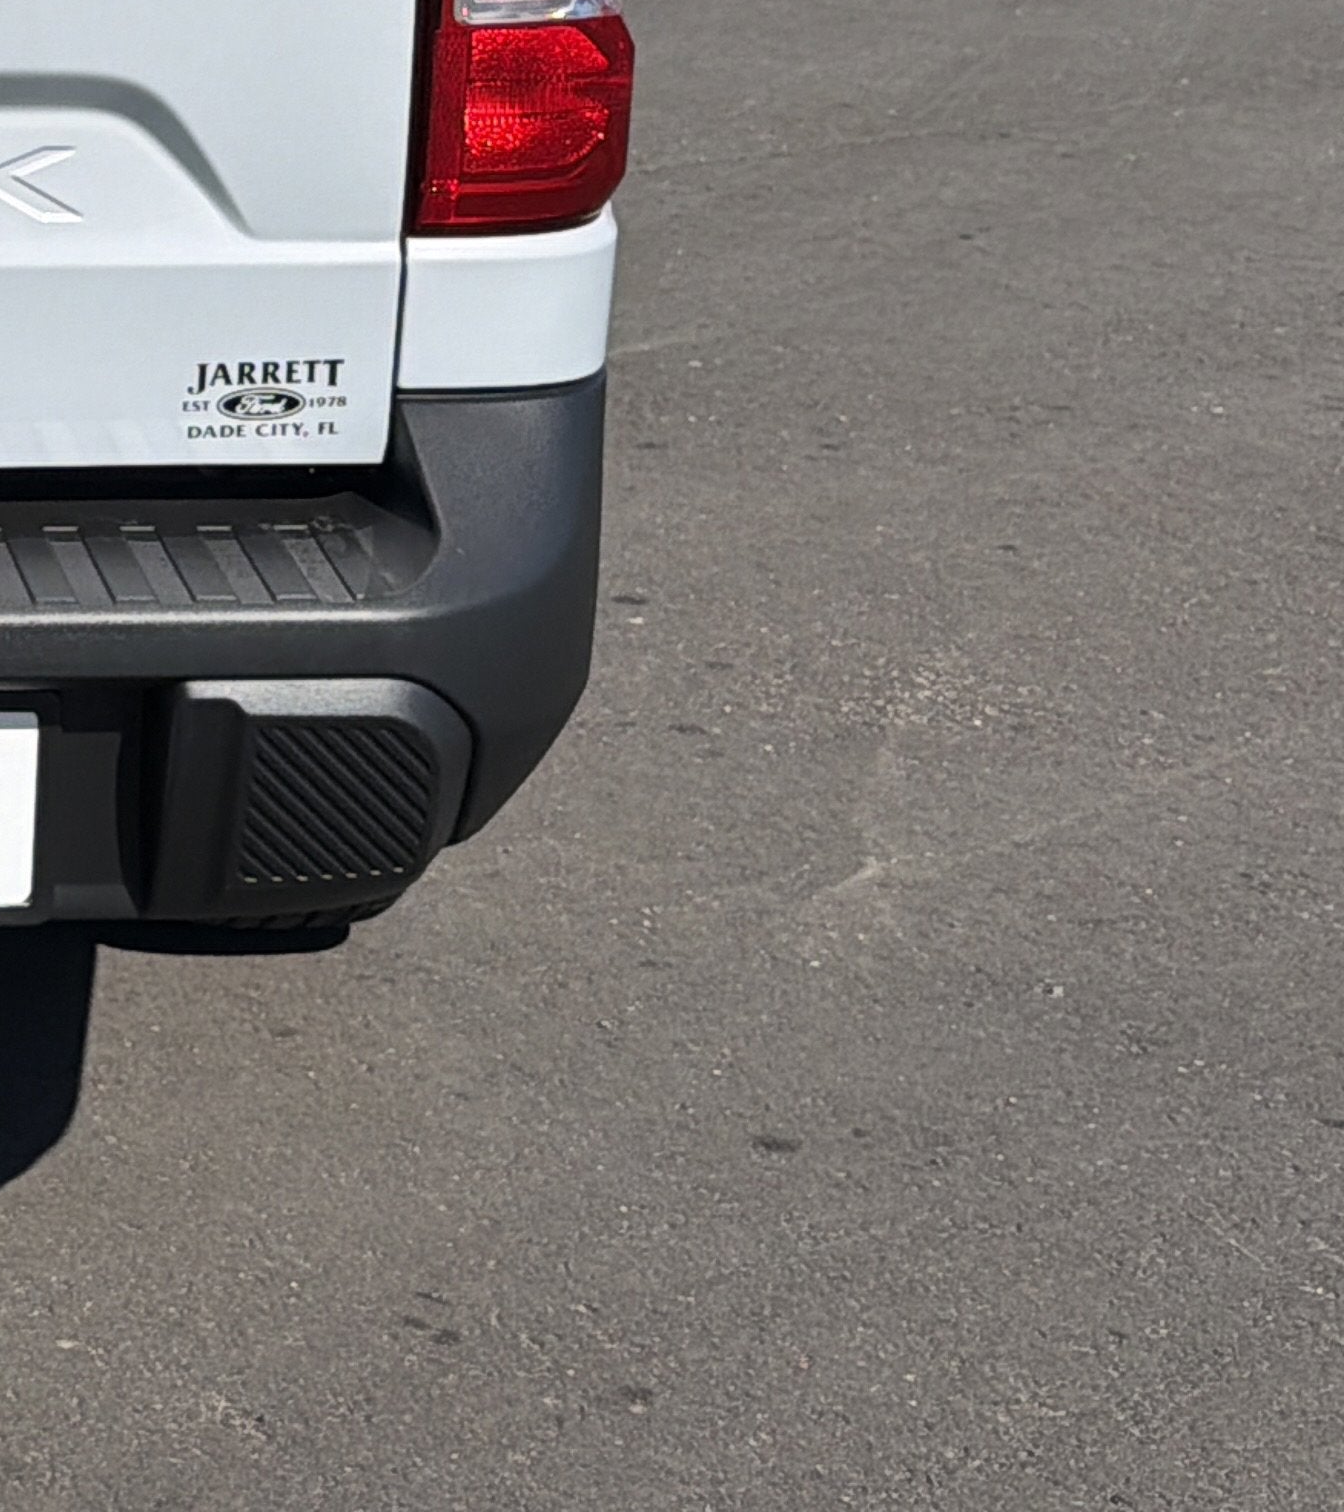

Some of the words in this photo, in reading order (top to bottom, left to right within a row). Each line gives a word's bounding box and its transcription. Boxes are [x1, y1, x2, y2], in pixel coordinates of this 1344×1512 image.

[187, 359, 345, 395] JARRETT
[182, 400, 211, 412] EST
[309, 396, 348, 408] 1978
[187, 425, 248, 439] DADE
[255, 422, 310, 438] CITY,
[317, 421, 339, 436] FL
